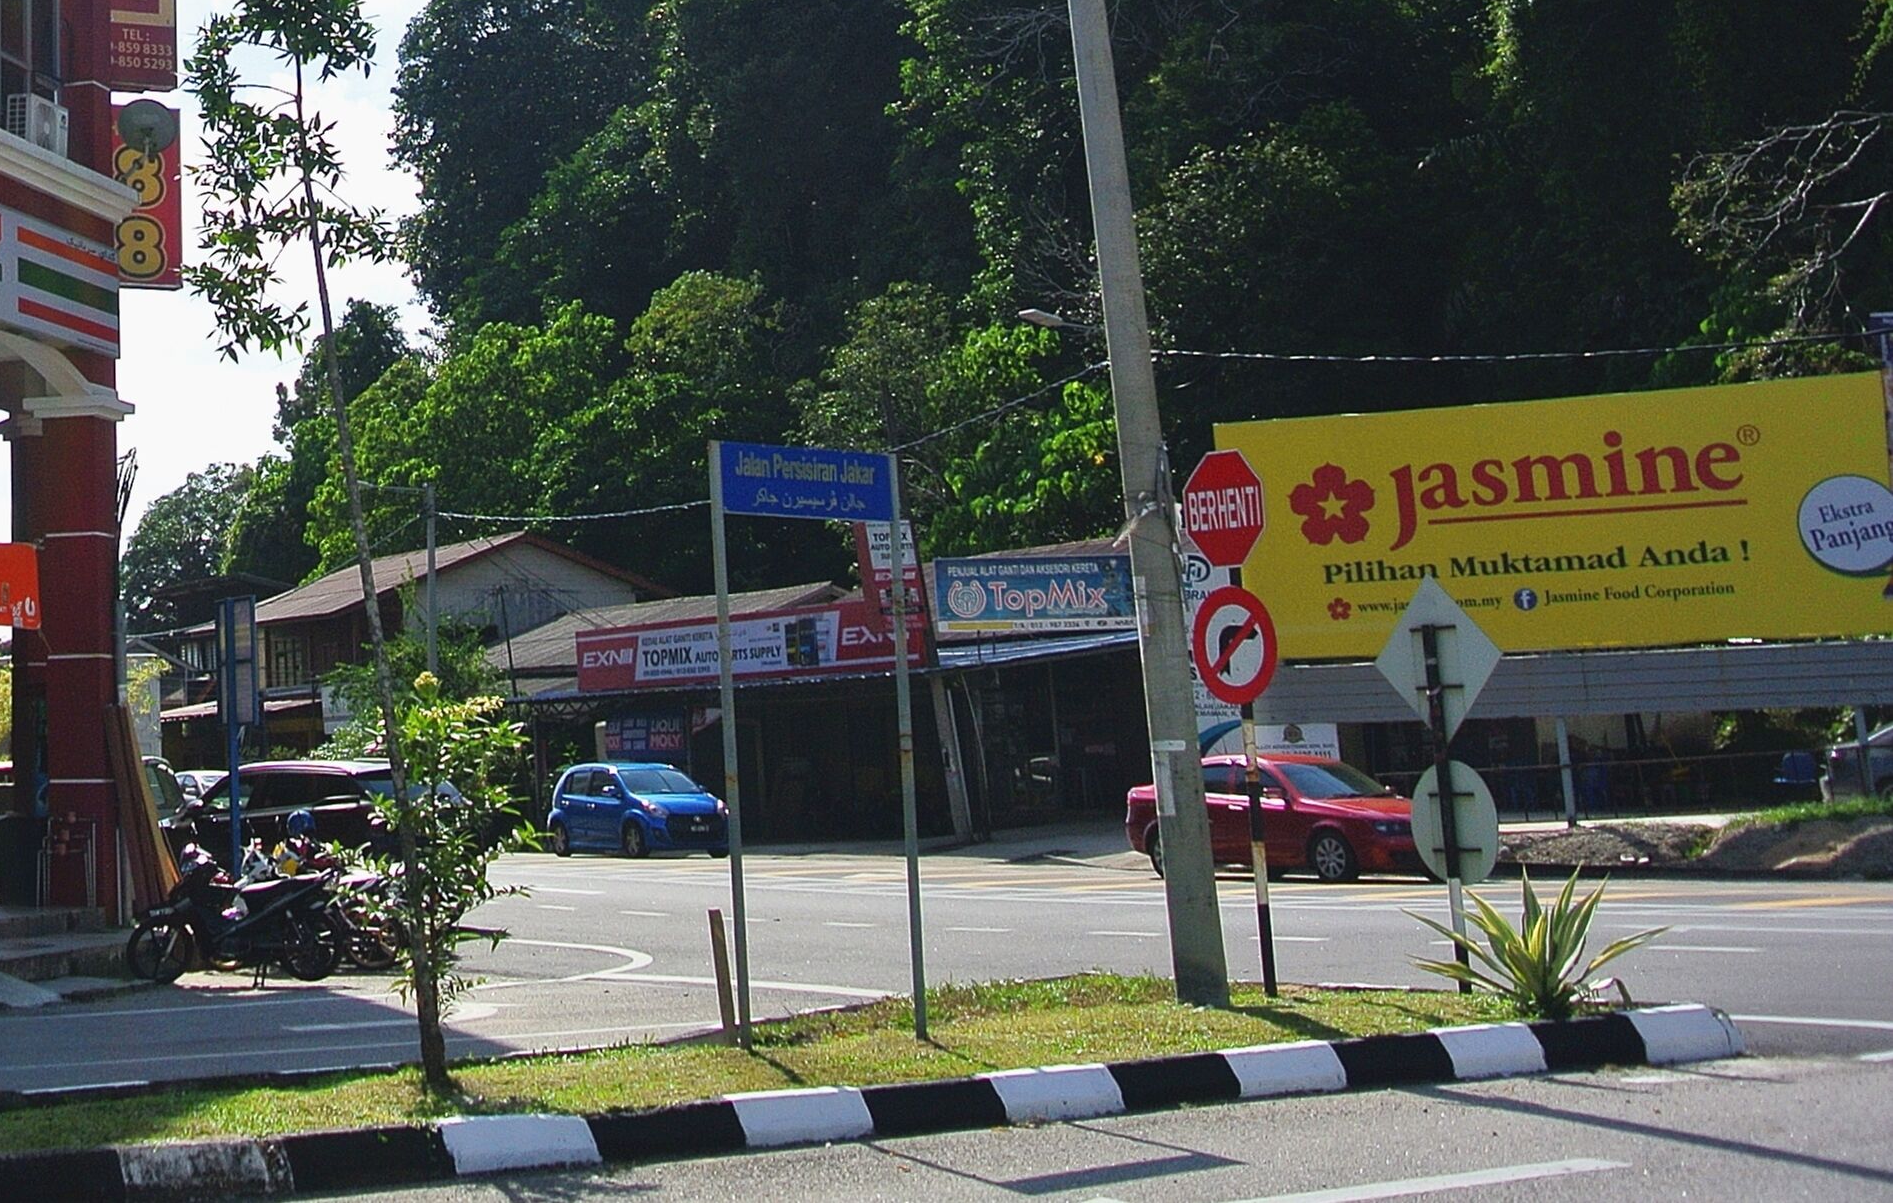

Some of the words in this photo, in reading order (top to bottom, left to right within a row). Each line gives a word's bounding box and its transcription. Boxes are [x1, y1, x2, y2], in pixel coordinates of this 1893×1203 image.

[142, 44, 173, 56] 8333
[143, 58, 173, 70] 5293
[735, 451, 771, 478] Jalan
[773, 452, 838, 482] Persisiran
[840, 459, 875, 485] Jakar
[1187, 485, 1262, 532] BERHENTI
[1818, 500, 1875, 524] Ekstra
[979, 565, 997, 576] ALAT
[998, 564, 1020, 576] GANTI
[1020, 564, 1036, 575] DAN
[1071, 562, 1099, 574] KERETA
[1322, 558, 1439, 585] Pilihan
[1450, 546, 1627, 578] Muktamad
[1638, 541, 1731, 568] Anda
[988, 578, 1108, 617] TopMix
[1544, 588, 1601, 606] Jasmine
[1604, 585, 1640, 601] Food
[1644, 581, 1735, 601] Corporation
[642, 646, 692, 667] TOPMIX
[695, 650, 719, 664] AUTO
[749, 644, 781, 660] SUPPLY
[650, 734, 682, 748] MOLY
